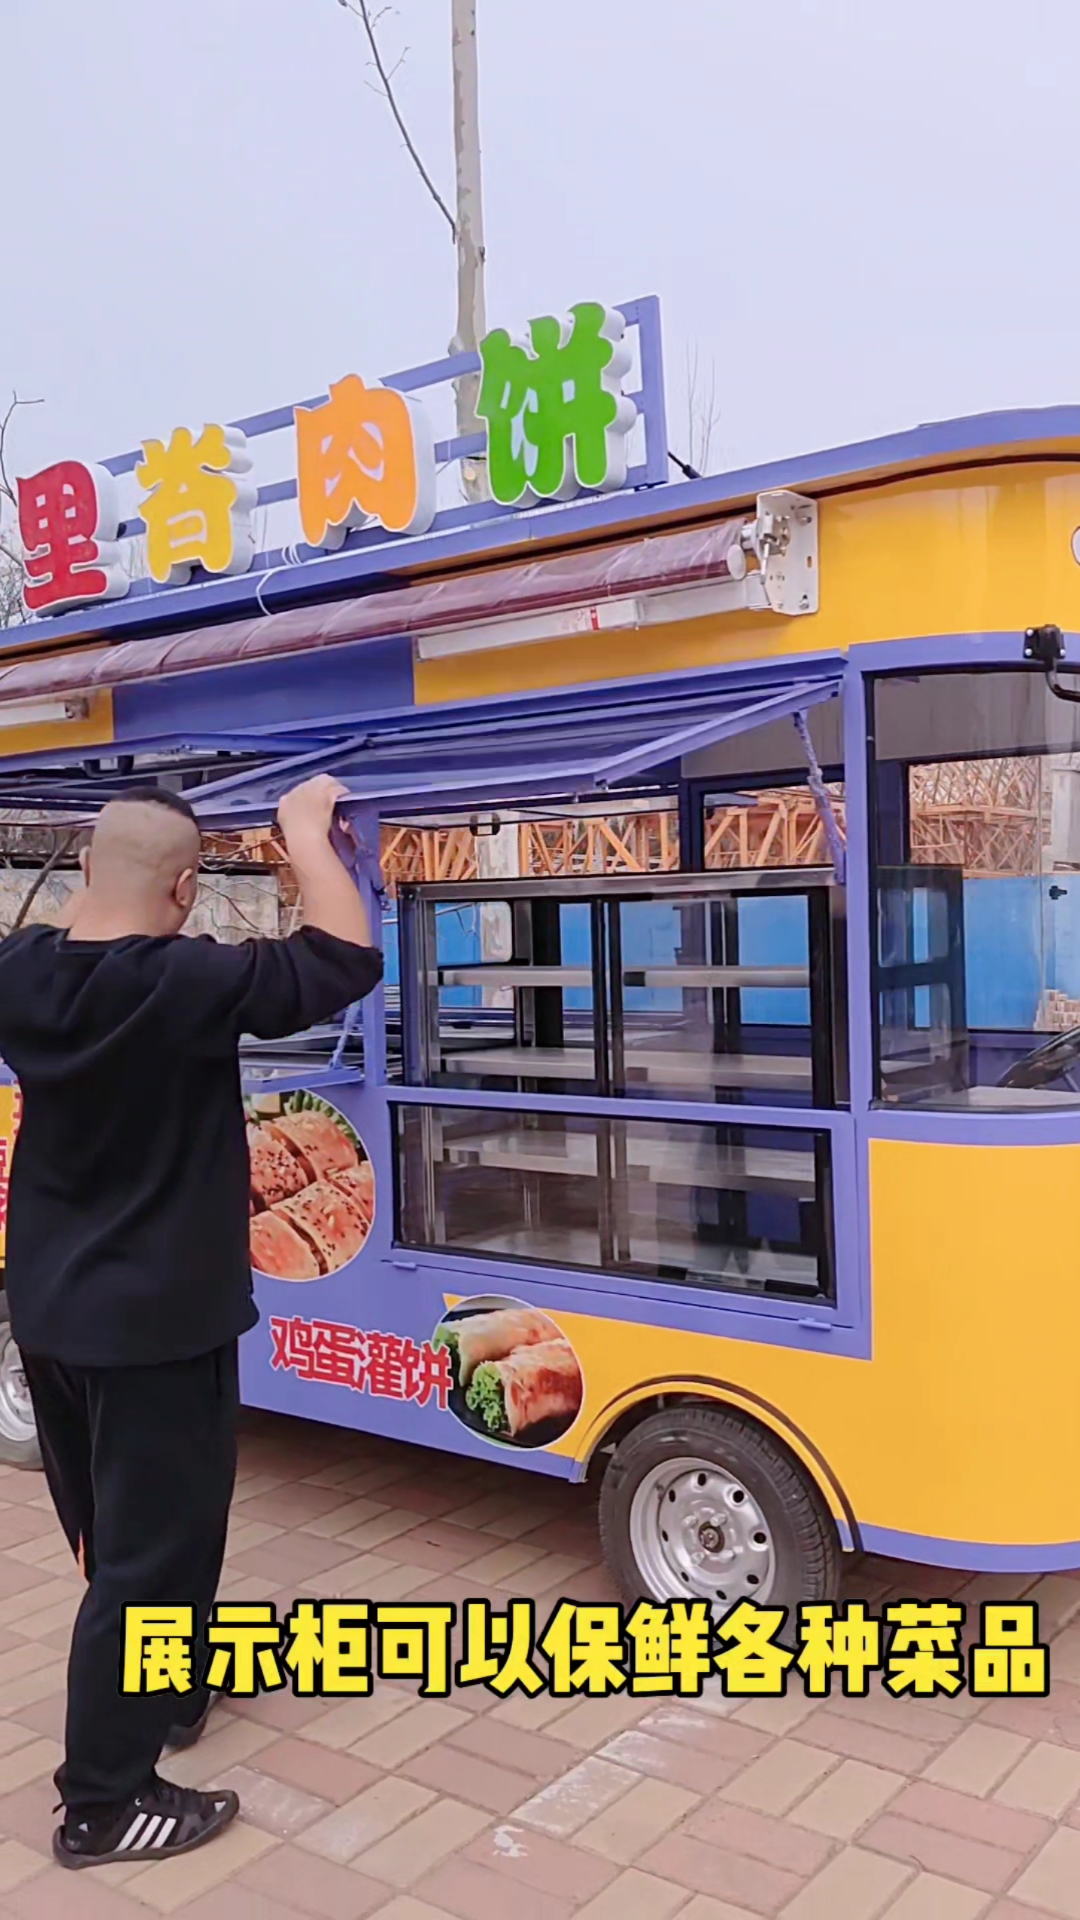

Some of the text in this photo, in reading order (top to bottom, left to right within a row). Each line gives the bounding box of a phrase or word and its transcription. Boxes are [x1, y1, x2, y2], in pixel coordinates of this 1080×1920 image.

[16, 302, 620, 612] 里脊肉饼
[270, 1316, 452, 1409] 鸡蛋灌饼
